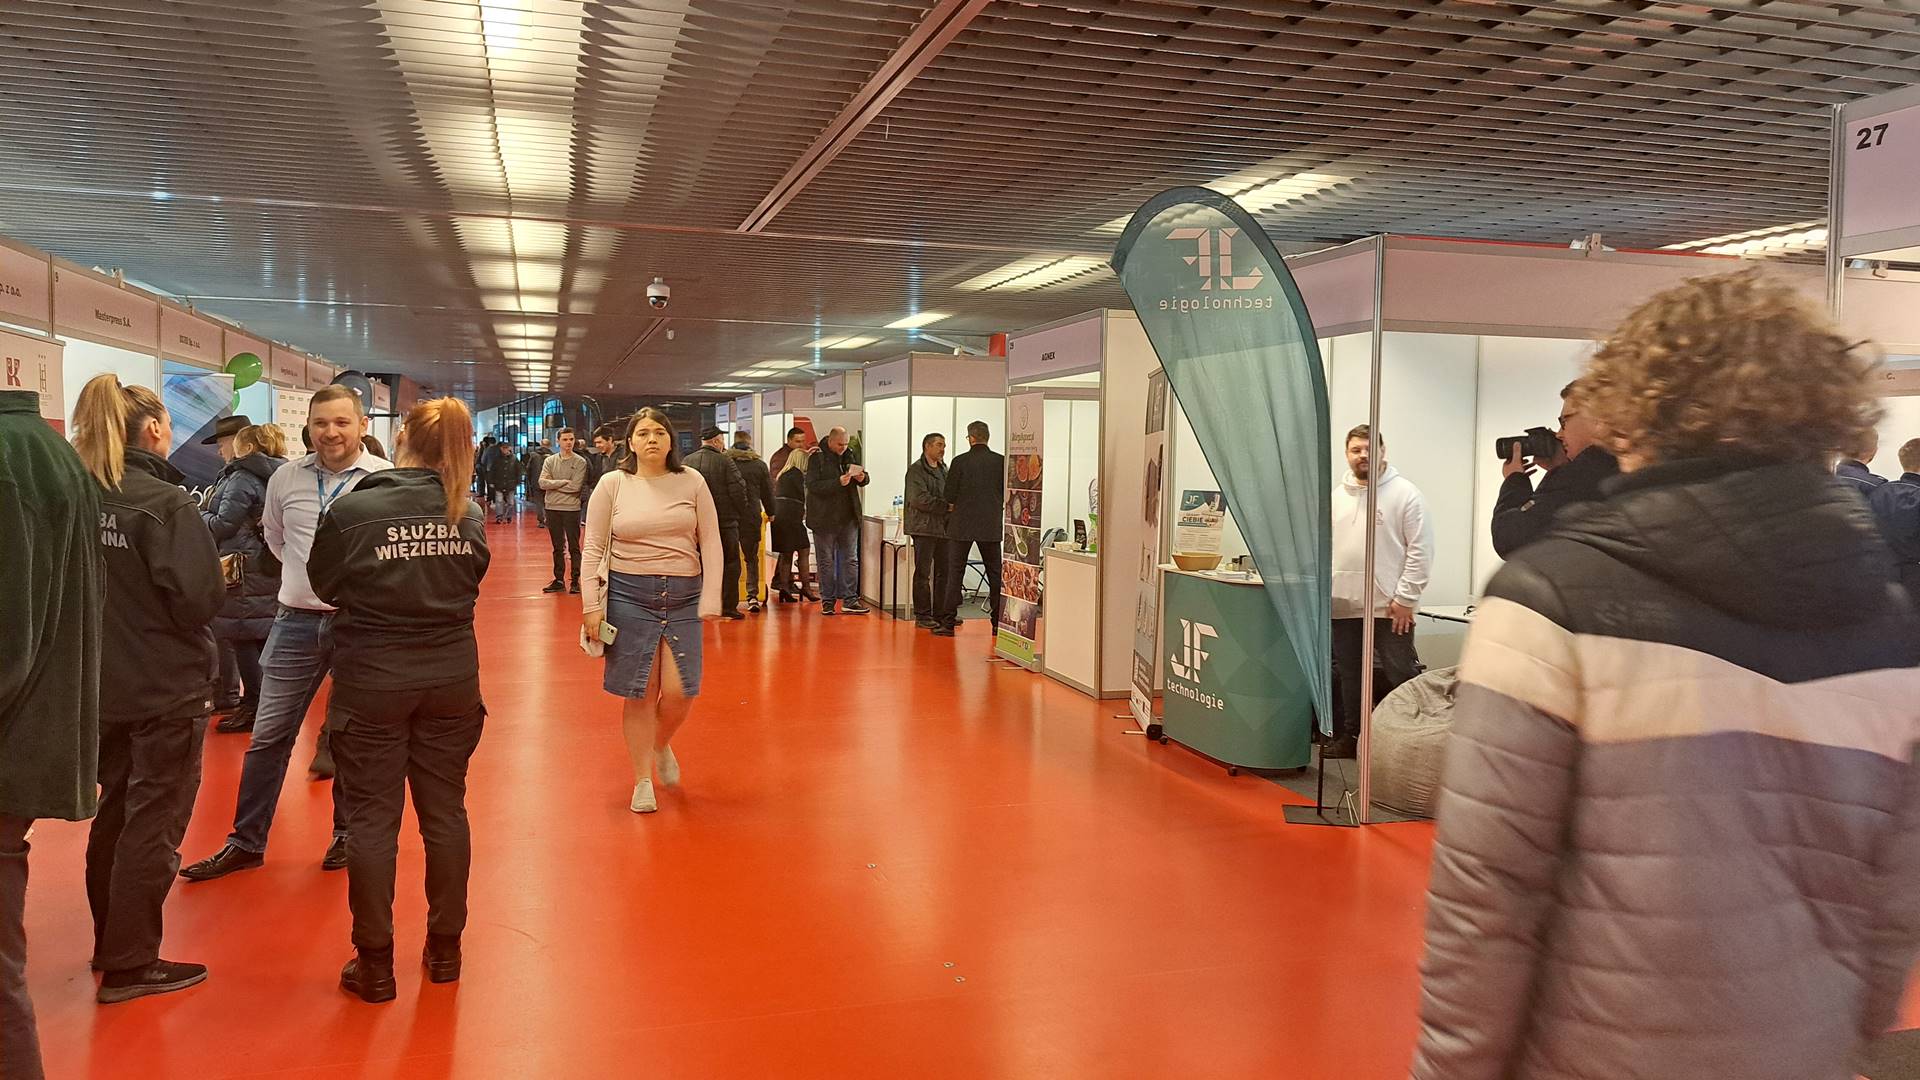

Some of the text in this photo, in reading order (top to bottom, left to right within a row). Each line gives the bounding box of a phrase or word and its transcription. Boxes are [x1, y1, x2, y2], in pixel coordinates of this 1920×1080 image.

[1856, 123, 1889, 150] 27
[386, 522, 461, 542] SŁUŻBA
[374, 540, 473, 561] WIĘZIENNA
[1170, 618, 1219, 684] JF
[1166, 678, 1224, 710] technologie
